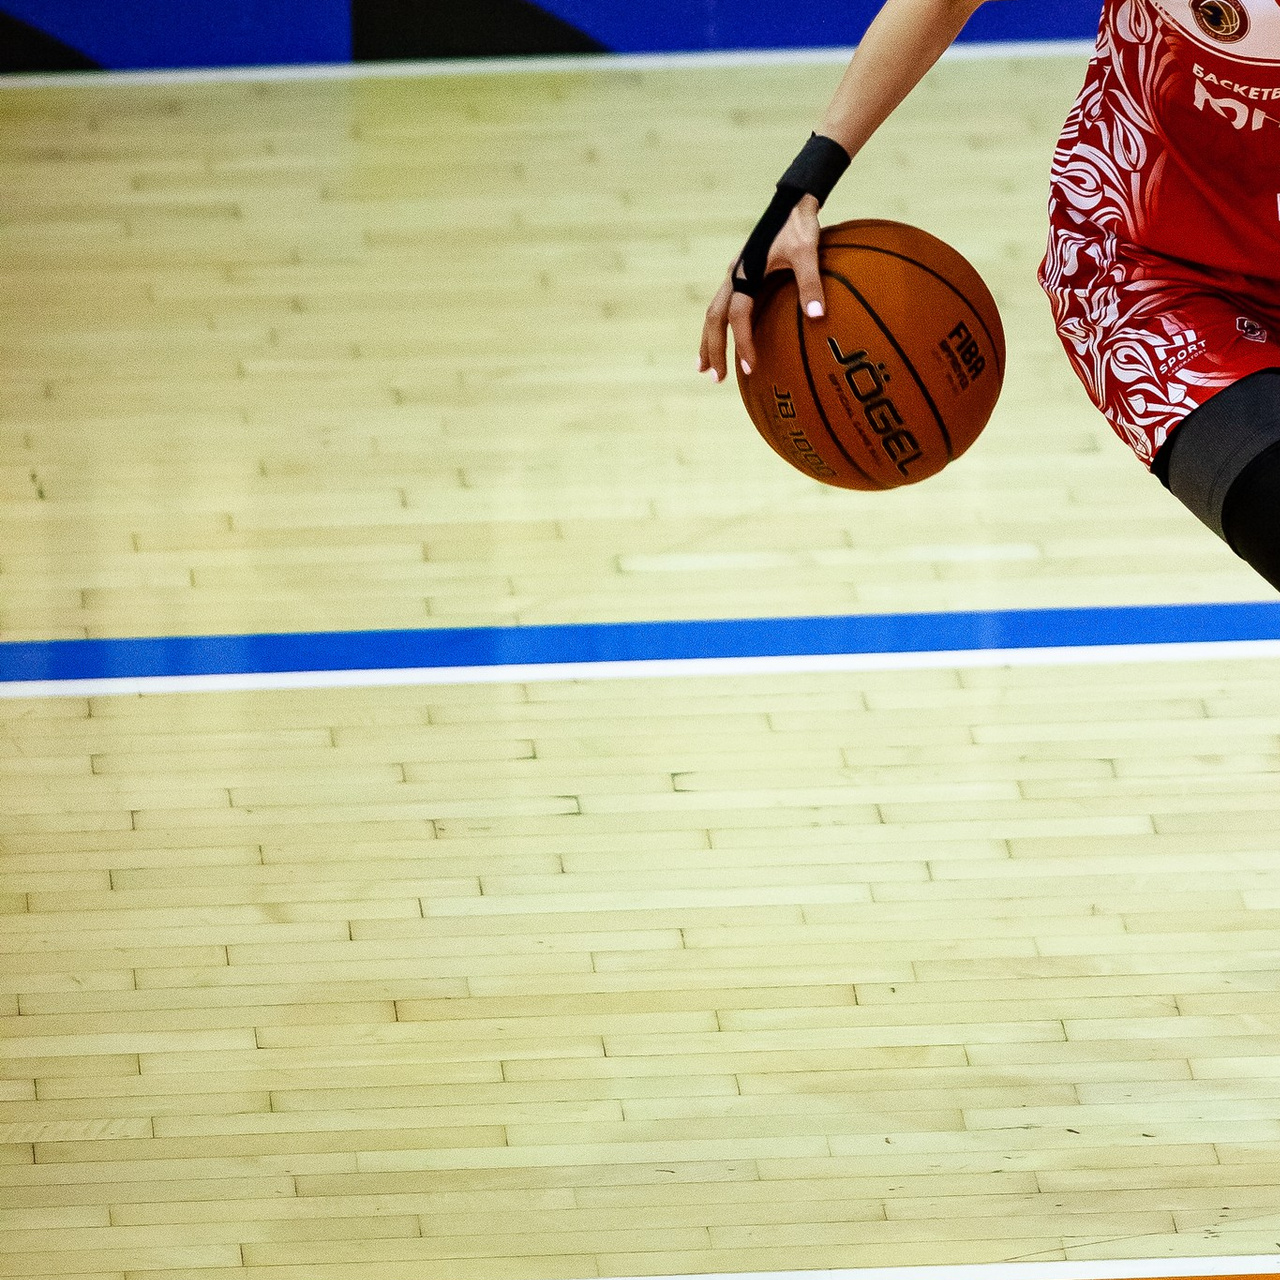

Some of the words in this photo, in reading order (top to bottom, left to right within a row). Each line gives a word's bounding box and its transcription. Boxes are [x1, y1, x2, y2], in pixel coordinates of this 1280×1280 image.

[947, 320, 986, 381] FIBA
[1159, 340, 1206, 375] SPORT
[826, 336, 923, 478] JÖGEL
